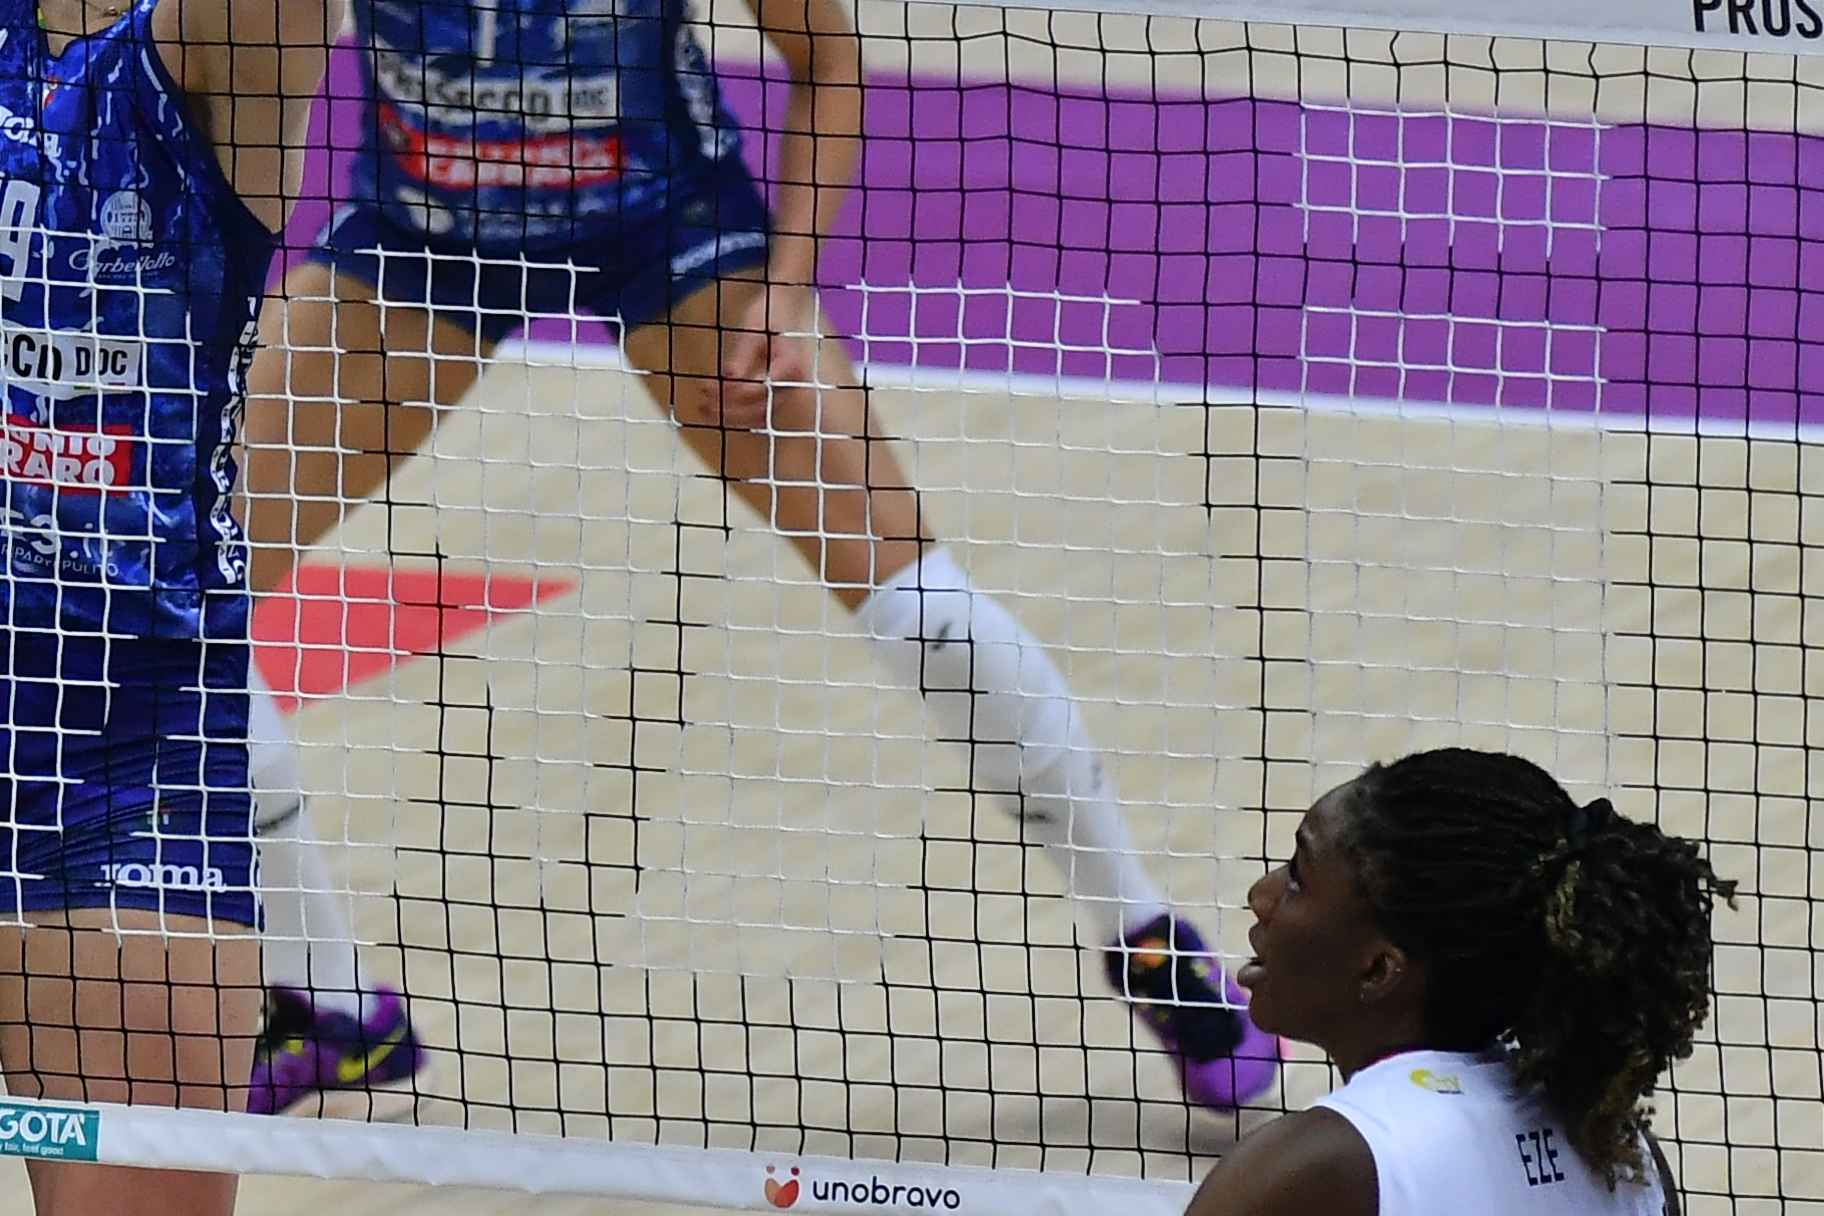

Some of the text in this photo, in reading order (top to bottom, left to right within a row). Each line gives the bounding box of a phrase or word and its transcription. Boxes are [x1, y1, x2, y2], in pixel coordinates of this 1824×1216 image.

[75, 345, 128, 376] DOC
[1516, 1128, 1566, 1186] EZE
[813, 1175, 961, 1209] unobravo
